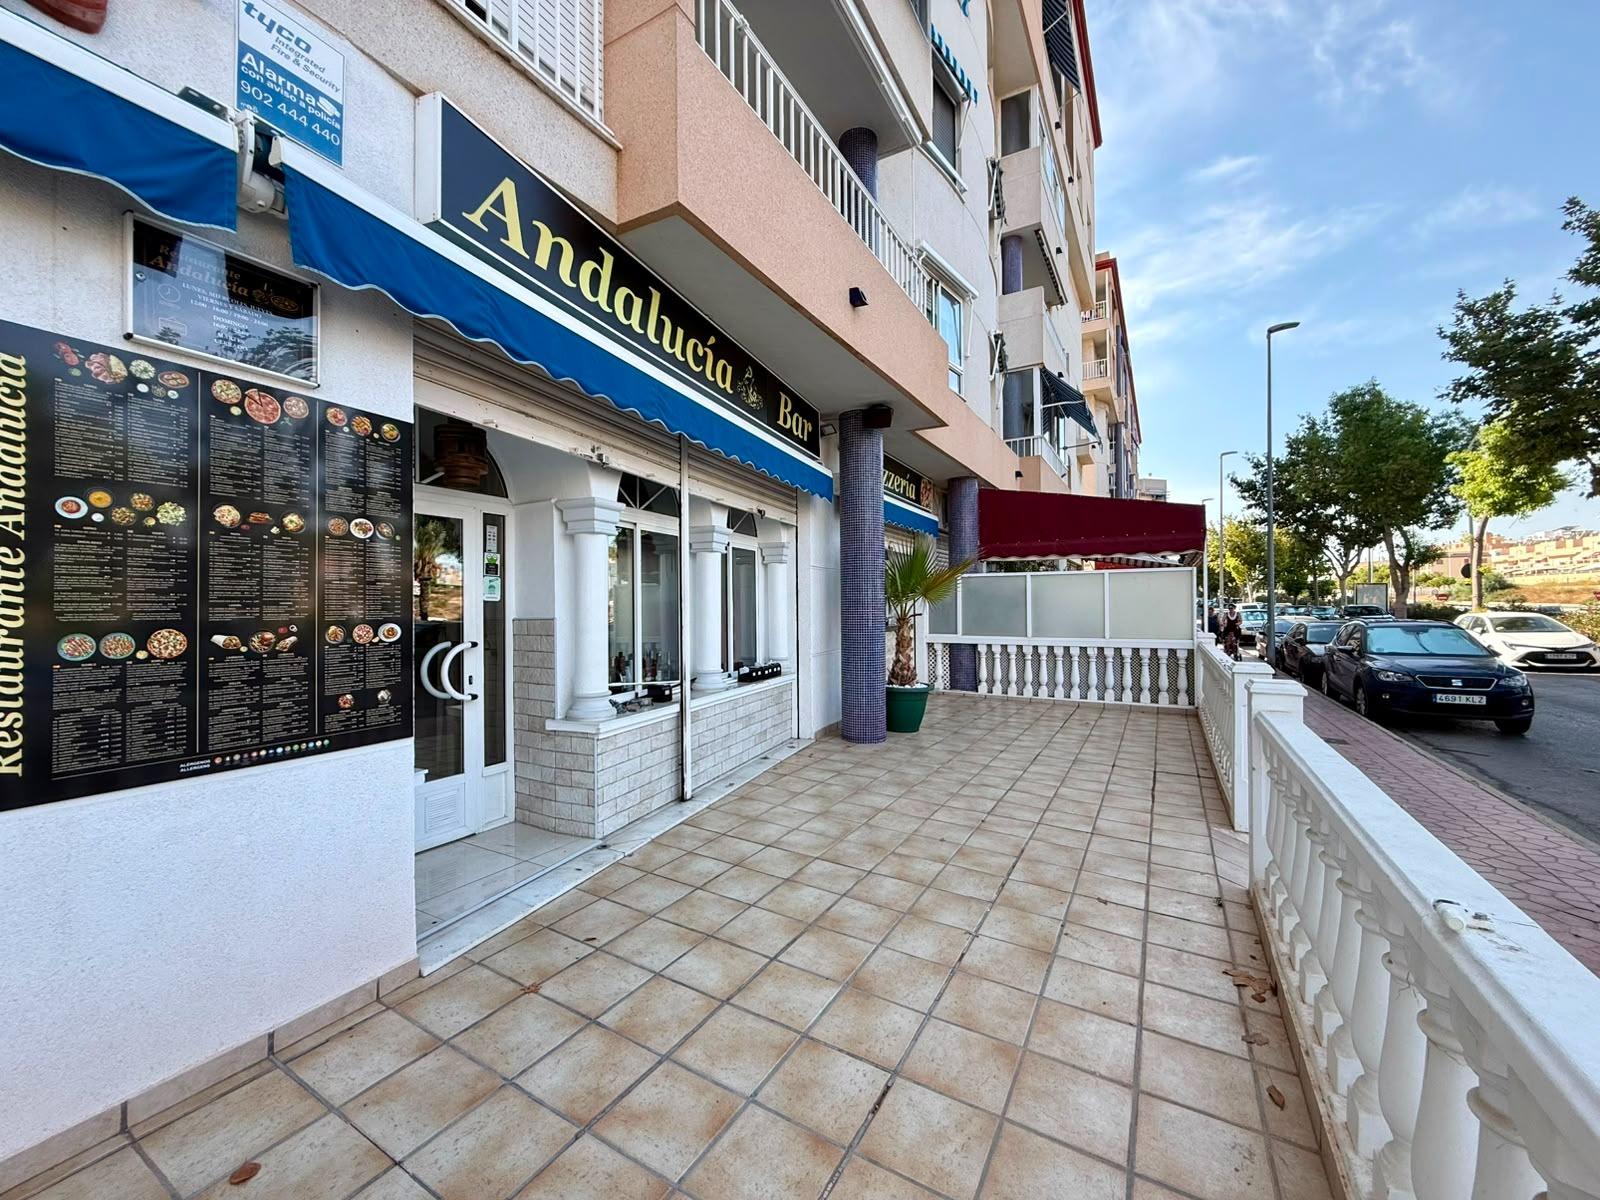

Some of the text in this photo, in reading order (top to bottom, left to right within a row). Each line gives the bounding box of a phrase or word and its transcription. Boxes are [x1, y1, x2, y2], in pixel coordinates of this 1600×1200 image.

[241, 1, 312, 54] tyco
[241, 52, 317, 107] Alarma
[270, 44, 341, 93] Fire & Security
[274, 37, 326, 73] Integrated
[241, 66, 264, 83] con
[266, 81, 297, 102] aviso
[299, 100, 306, 109] a
[240, 80, 273, 107] 902
[277, 103, 308, 127] 444
[312, 123, 340, 146] 440
[462, 177, 734, 395] Andalucía
[777, 391, 813, 442] Bar
[882, 469, 916, 500] zzería
[1438, 695, 1484, 704] 4691 KLZ
